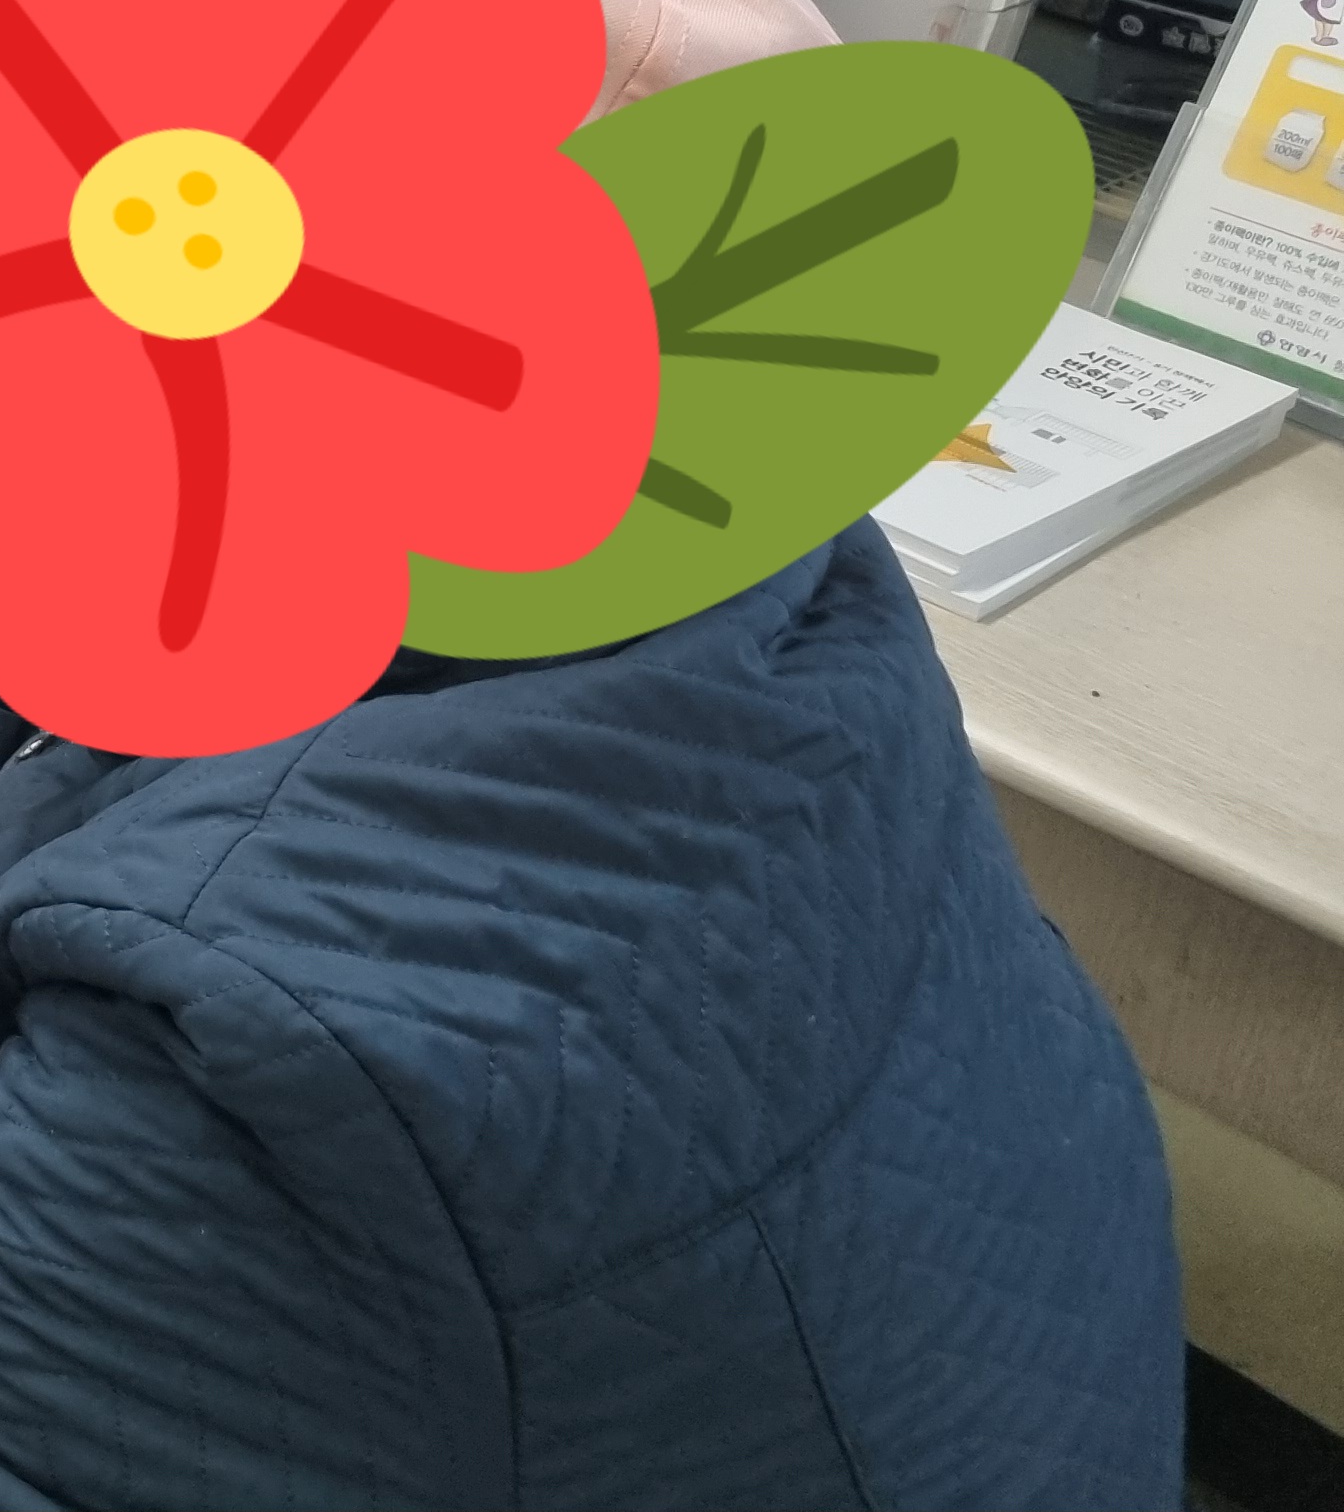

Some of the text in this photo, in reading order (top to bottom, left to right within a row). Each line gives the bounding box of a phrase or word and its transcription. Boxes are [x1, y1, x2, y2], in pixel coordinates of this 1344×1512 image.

[1277, 128, 1312, 147] 200ml
[1078, 350, 1209, 404] 시민과 함께
[1279, 337, 1329, 365] 안양시
[1039, 366, 1170, 421] 안양의 기록
[1060, 357, 1188, 412] 변화를 이끈
